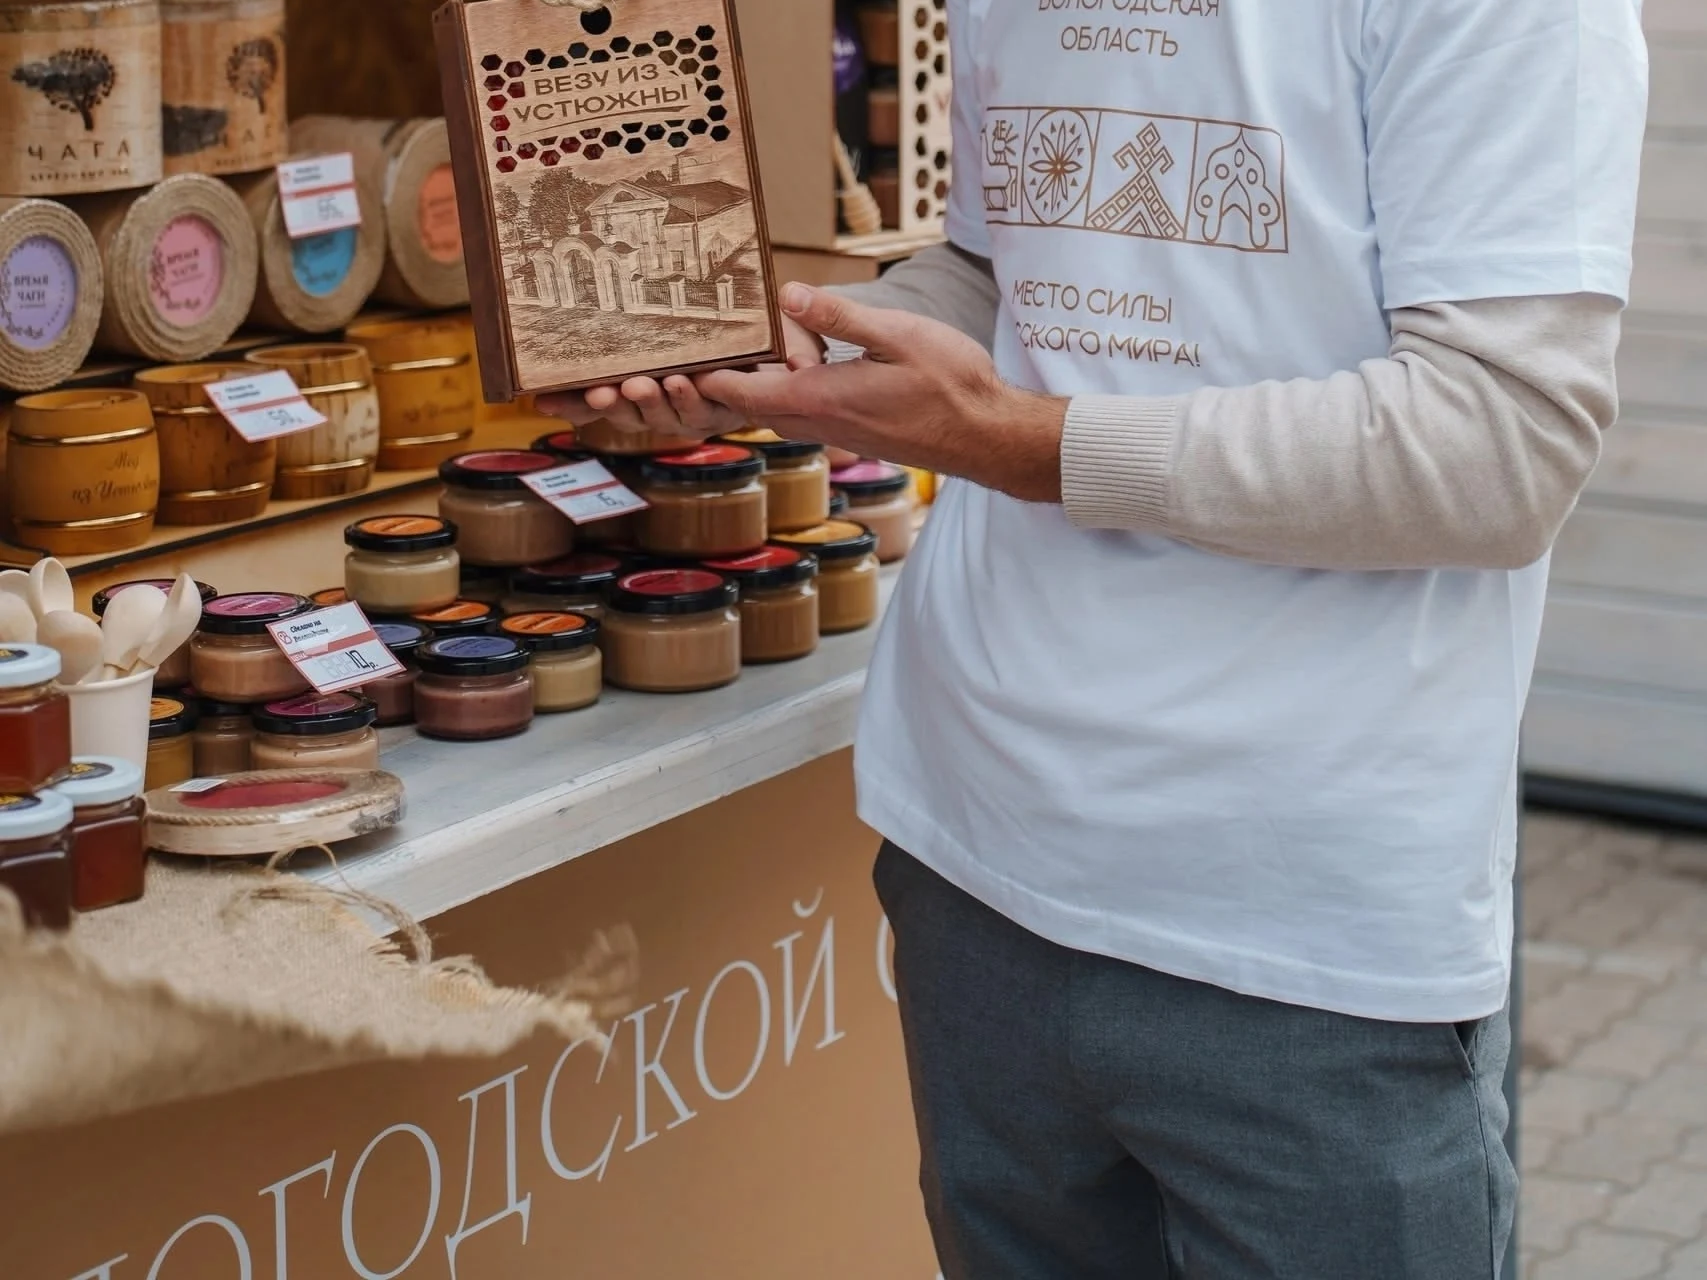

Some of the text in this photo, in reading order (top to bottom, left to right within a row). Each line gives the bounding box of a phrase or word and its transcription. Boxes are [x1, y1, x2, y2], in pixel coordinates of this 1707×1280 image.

[1060, 25, 1180, 57] ОБЛАСТЬ
[534, 62, 660, 96] ВЕЗУ ИЗ
[512, 83, 689, 123] УСТЮЖНЫ
[14, 274, 49, 287] ВРЕМЯ
[17, 290, 46, 302] ЧАГИ
[1011, 279, 1172, 323] МЕСТО СИЛЫ
[1015, 321, 1202, 367] СКОГО МИРА!
[68, 886, 847, 1280] ГОДСКОЙ
